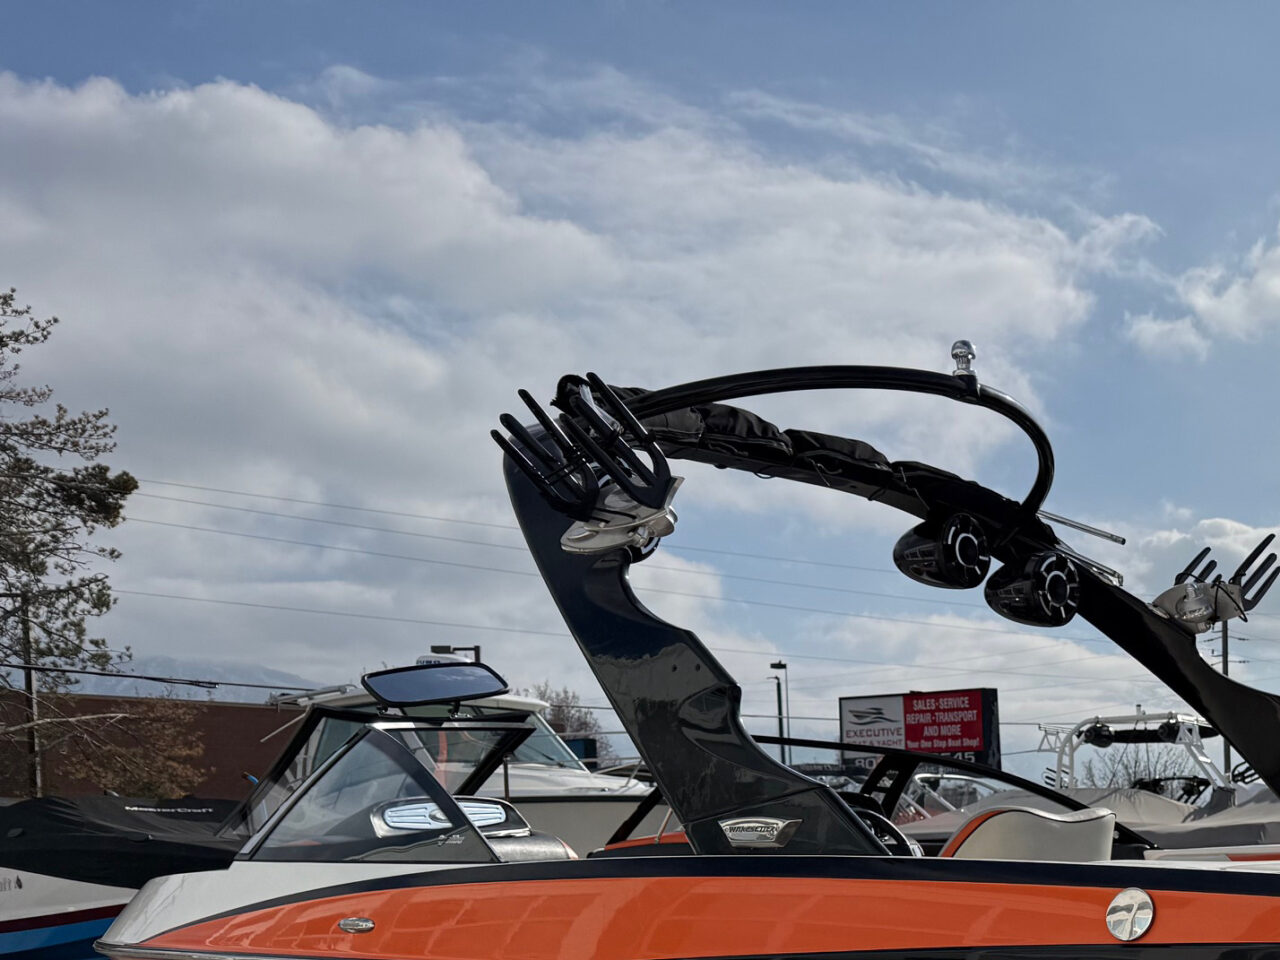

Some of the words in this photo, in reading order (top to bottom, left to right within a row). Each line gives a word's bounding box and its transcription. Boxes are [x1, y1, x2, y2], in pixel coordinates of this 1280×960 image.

[846, 727, 903, 738] EXECUTIVE
[923, 726, 940, 737] AND
[940, 724, 962, 736] MORE
[876, 739, 903, 747] YACHT
[920, 739, 931, 748] One
[932, 739, 946, 749] Stop
